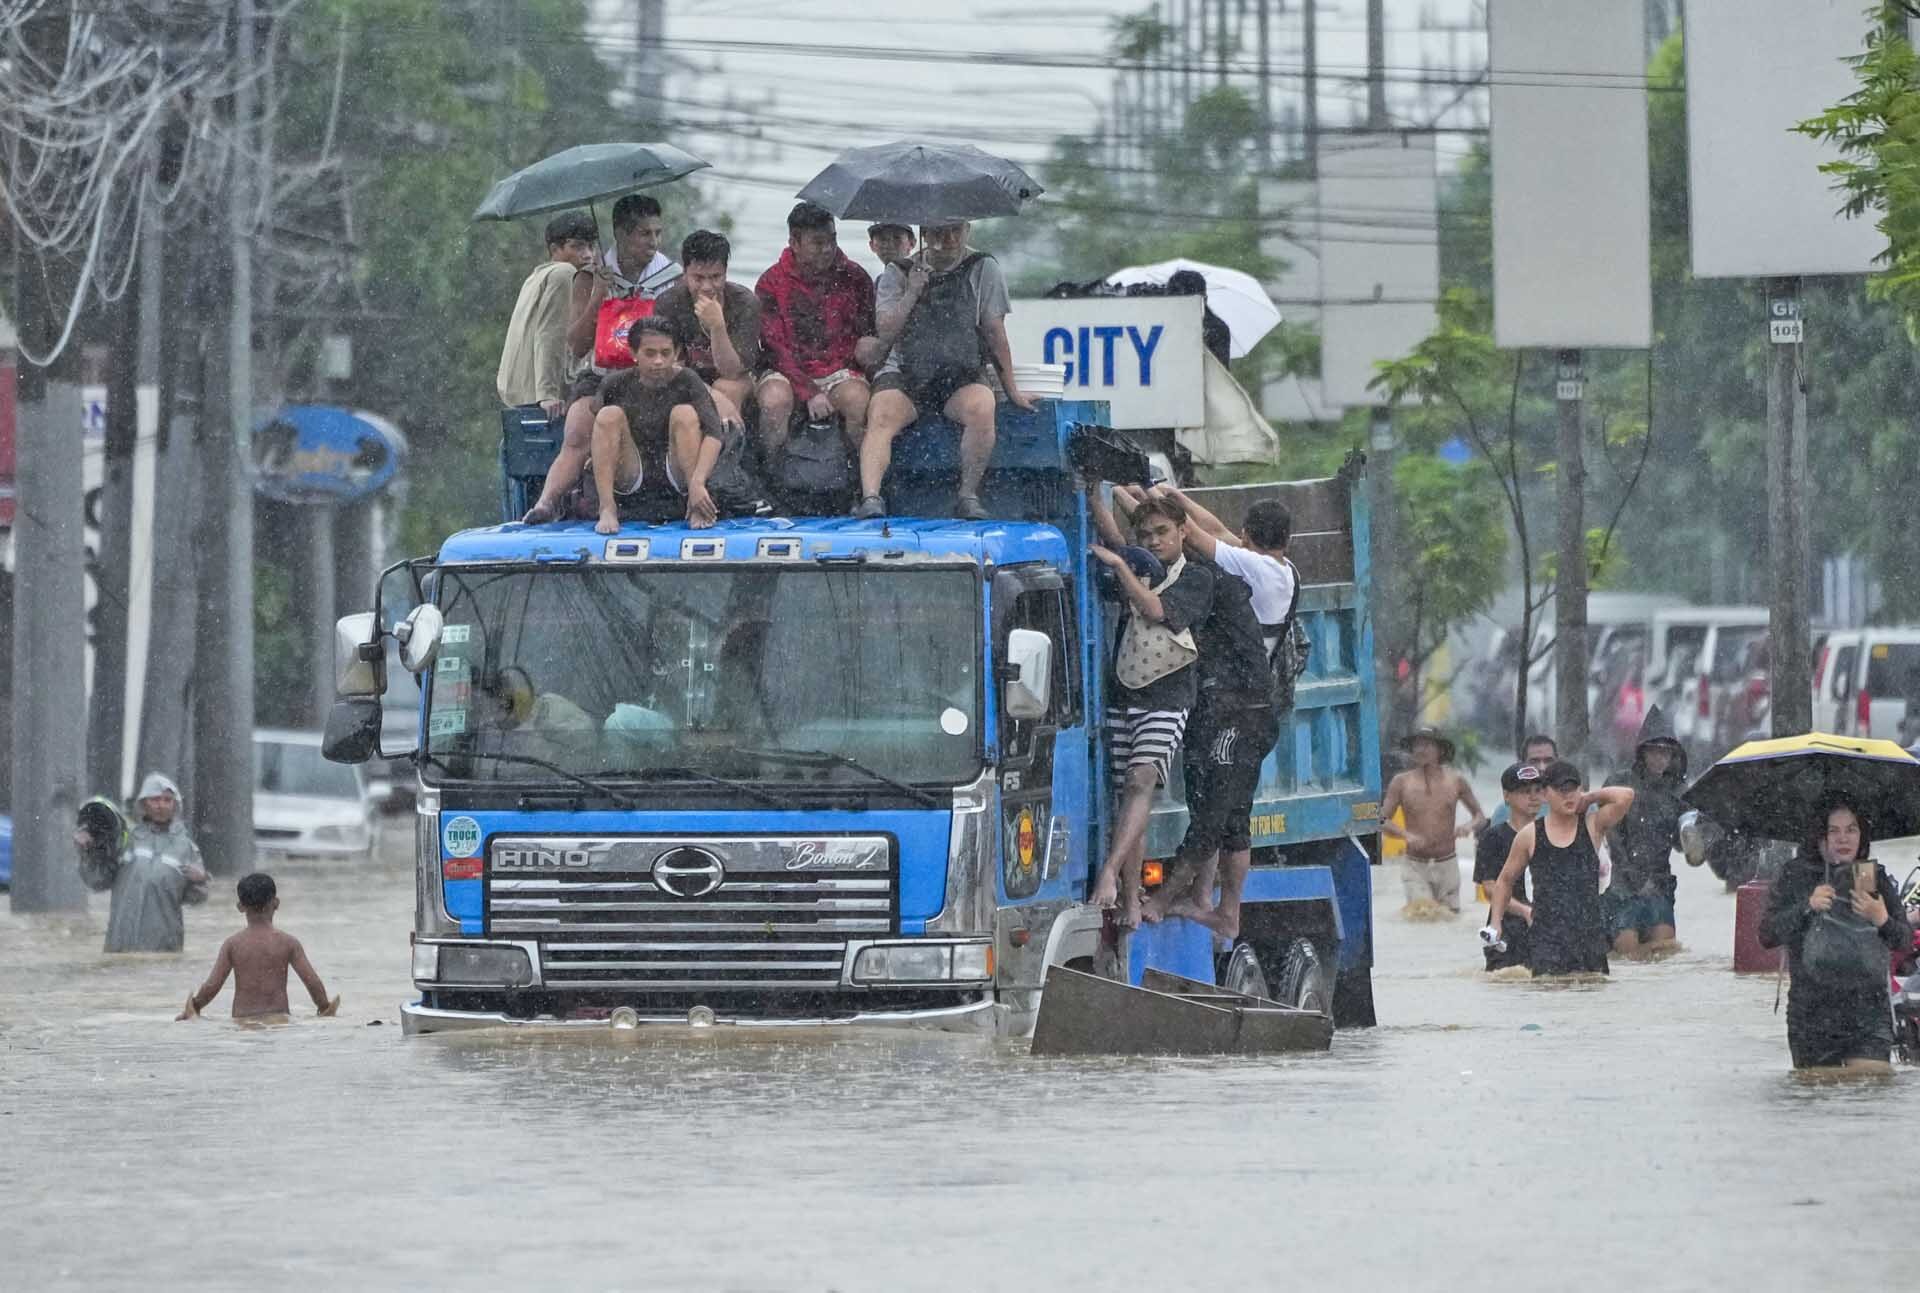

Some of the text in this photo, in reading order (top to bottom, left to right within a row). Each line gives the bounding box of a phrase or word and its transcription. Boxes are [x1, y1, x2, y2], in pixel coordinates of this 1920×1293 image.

[1043, 325, 1164, 386] CITY
[447, 830, 478, 841] TRUCK
[498, 849, 590, 867] HINO
